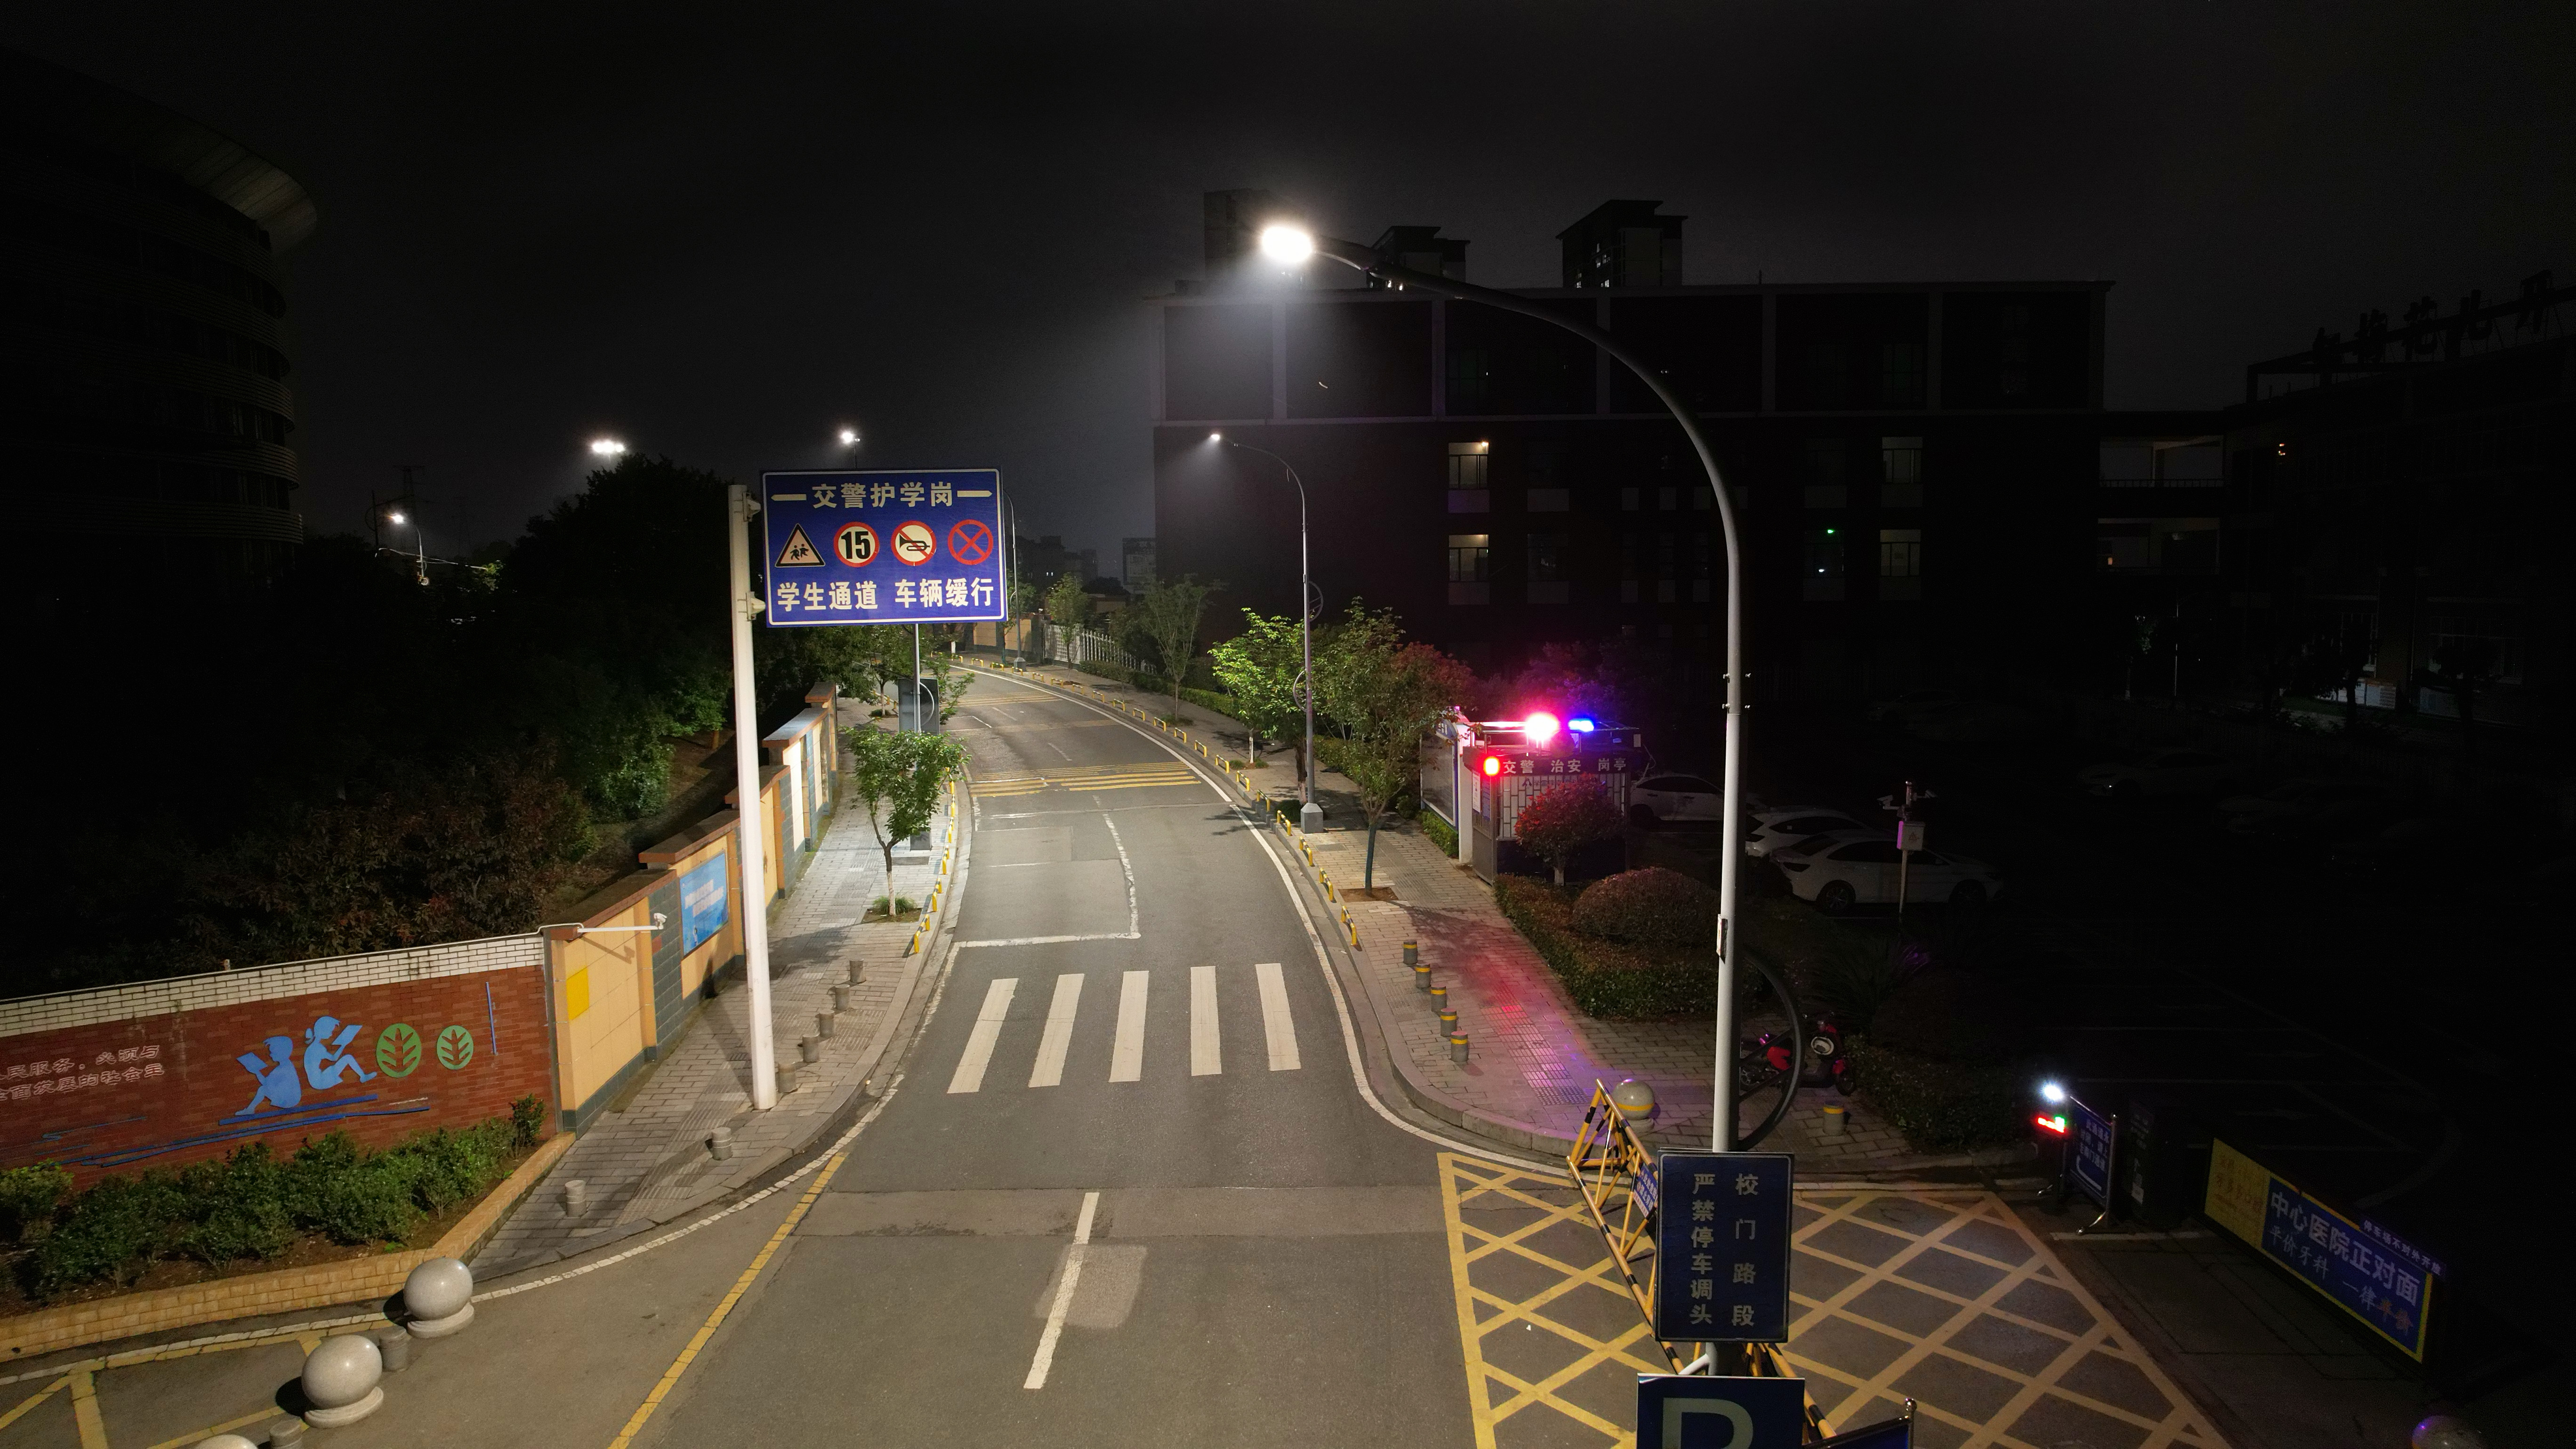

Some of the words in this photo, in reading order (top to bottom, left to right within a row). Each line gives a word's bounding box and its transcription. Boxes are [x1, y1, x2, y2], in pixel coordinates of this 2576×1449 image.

[812, 481, 953, 509] 交警护学岗
[841, 531, 871, 560] 15
[777, 580, 878, 612] 学生通道
[894, 577, 994, 609] 车辆缓行
[1503, 759, 1534, 774] 交警
[1551, 758, 1581, 773] 治安
[1598, 757, 1626, 771] 岗亭
[0, 1045, 160, 1080] 民服务。必须与
[1690, 1173, 1715, 1325] 严禁停车调头
[1731, 1173, 1759, 1327] 校门路段
[2270, 1191, 2421, 1306] 中心医院正对面
[2270, 1224, 2329, 1280] 平价牙科
